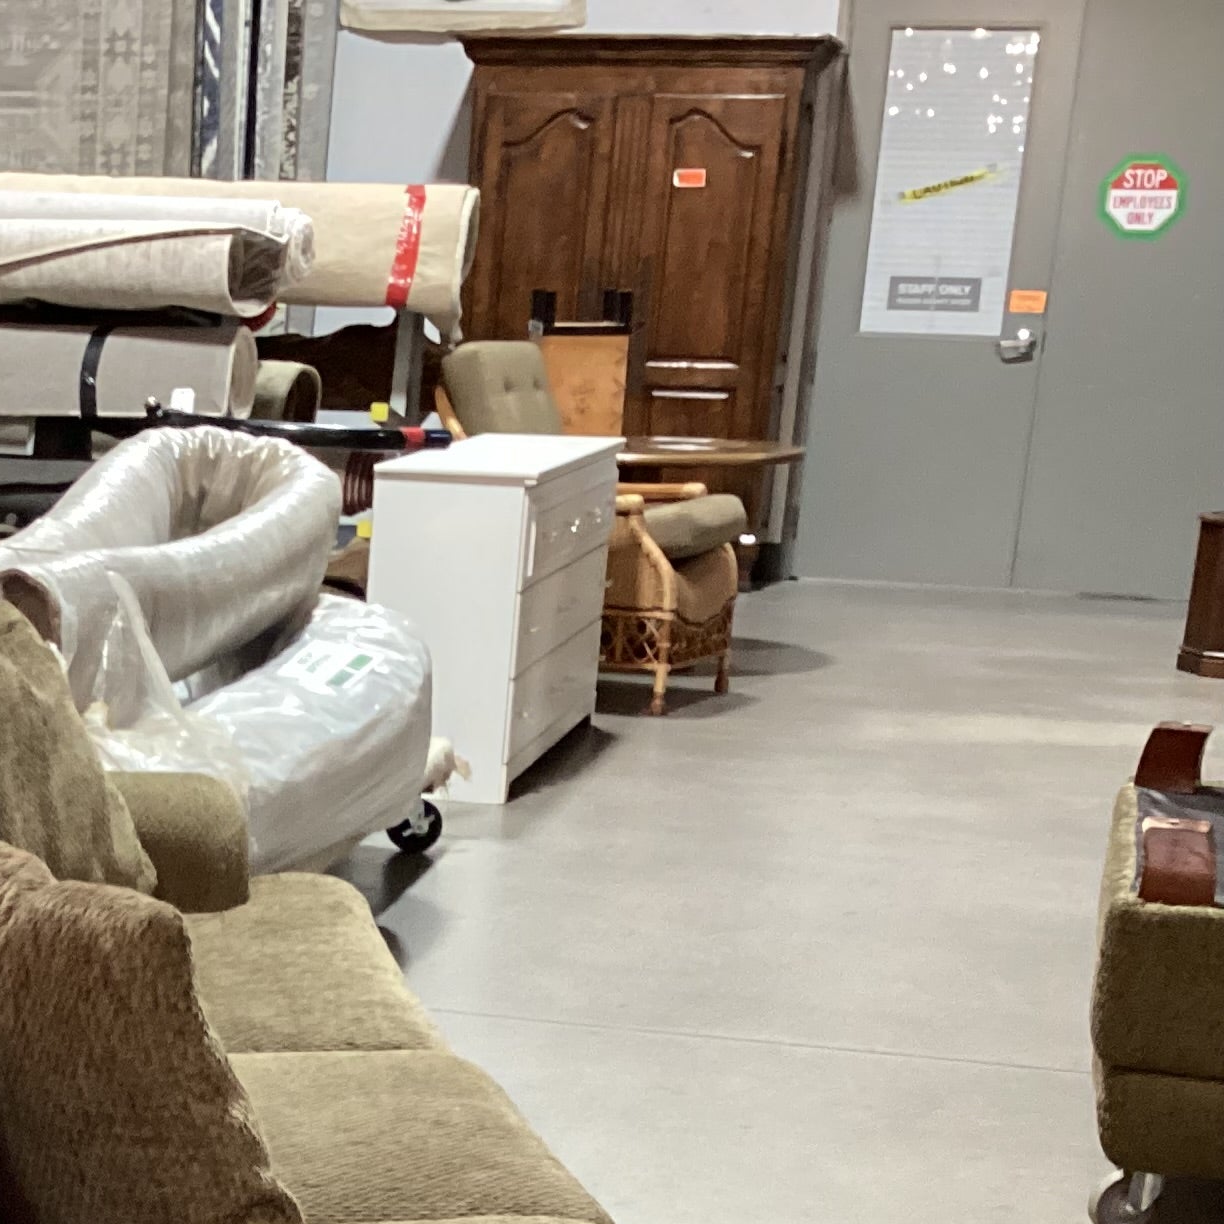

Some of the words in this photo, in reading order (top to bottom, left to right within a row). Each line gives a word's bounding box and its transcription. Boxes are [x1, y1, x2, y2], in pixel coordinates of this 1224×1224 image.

[1123, 168, 1168, 189] STOP
[1112, 195, 1173, 209] EMPLOYEES
[1126, 211, 1154, 225] ONLY
[897, 283, 936, 295] STAFF
[938, 284, 972, 296] ONLY
